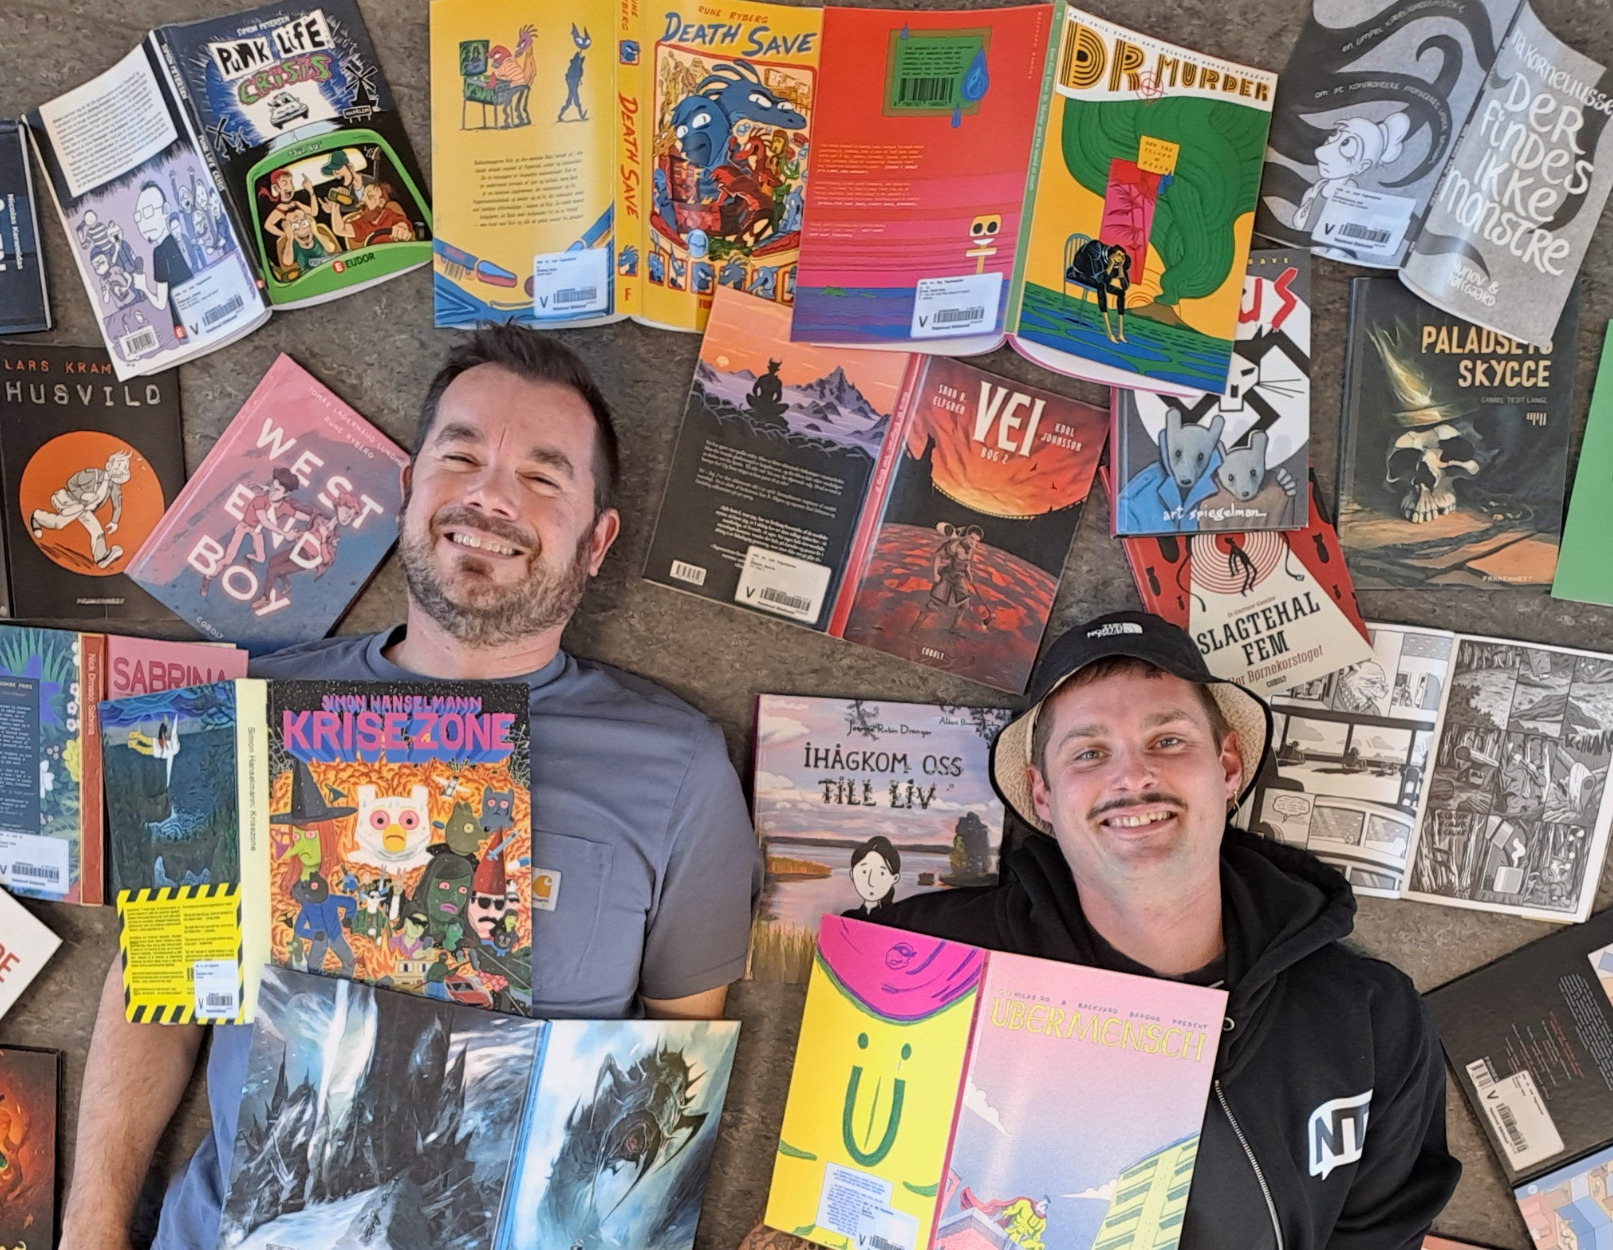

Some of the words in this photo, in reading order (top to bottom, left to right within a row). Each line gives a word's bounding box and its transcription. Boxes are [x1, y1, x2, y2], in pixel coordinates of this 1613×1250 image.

[698, 5, 722, 17] RUNE
[729, 11, 769, 24] RYBERG
[660, 12, 742, 44] DEATH
[742, 26, 817, 57] SAVE
[1155, 53, 1270, 102] MURDER
[618, 90, 640, 165] DEATH
[621, 164, 640, 220] SAVE
[1325, 223, 1335, 235] V
[345, 252, 376, 269] EUDOR
[540, 296, 548, 309] V
[625, 288, 631, 301] F
[190, 322, 199, 335] V
[919, 315, 928, 328] V
[4, 359, 49, 372] LARS
[66, 362, 112, 374] KRAM
[5, 381, 161, 407] HUSVILD
[933, 396, 965, 415] ELFGREN
[973, 381, 1047, 457] VEI
[1054, 423, 1075, 437] KARL
[1041, 433, 1082, 452] JOHNSSON
[980, 447, 999, 462] BOG
[256, 417, 384, 530] WEST
[1162, 506, 1184, 521] art
[1189, 503, 1267, 521] spiegelman
[187, 535, 291, 616] BOY
[746, 586, 755, 598] V
[196, 616, 224, 640] COBOLT
[1196, 591, 1321, 655] SLAGTEHAL
[1241, 630, 1290, 667] FEM
[1247, 644, 1323, 684] Børnekorstoget
[321, 694, 366, 713] SIMON
[371, 694, 483, 714] HANSELMANN
[283, 710, 516, 752] KRISEZONE
[922, 754, 964, 777] OSS
[198, 998, 204, 1010] V
[859, 1234, 866, 1246] V
